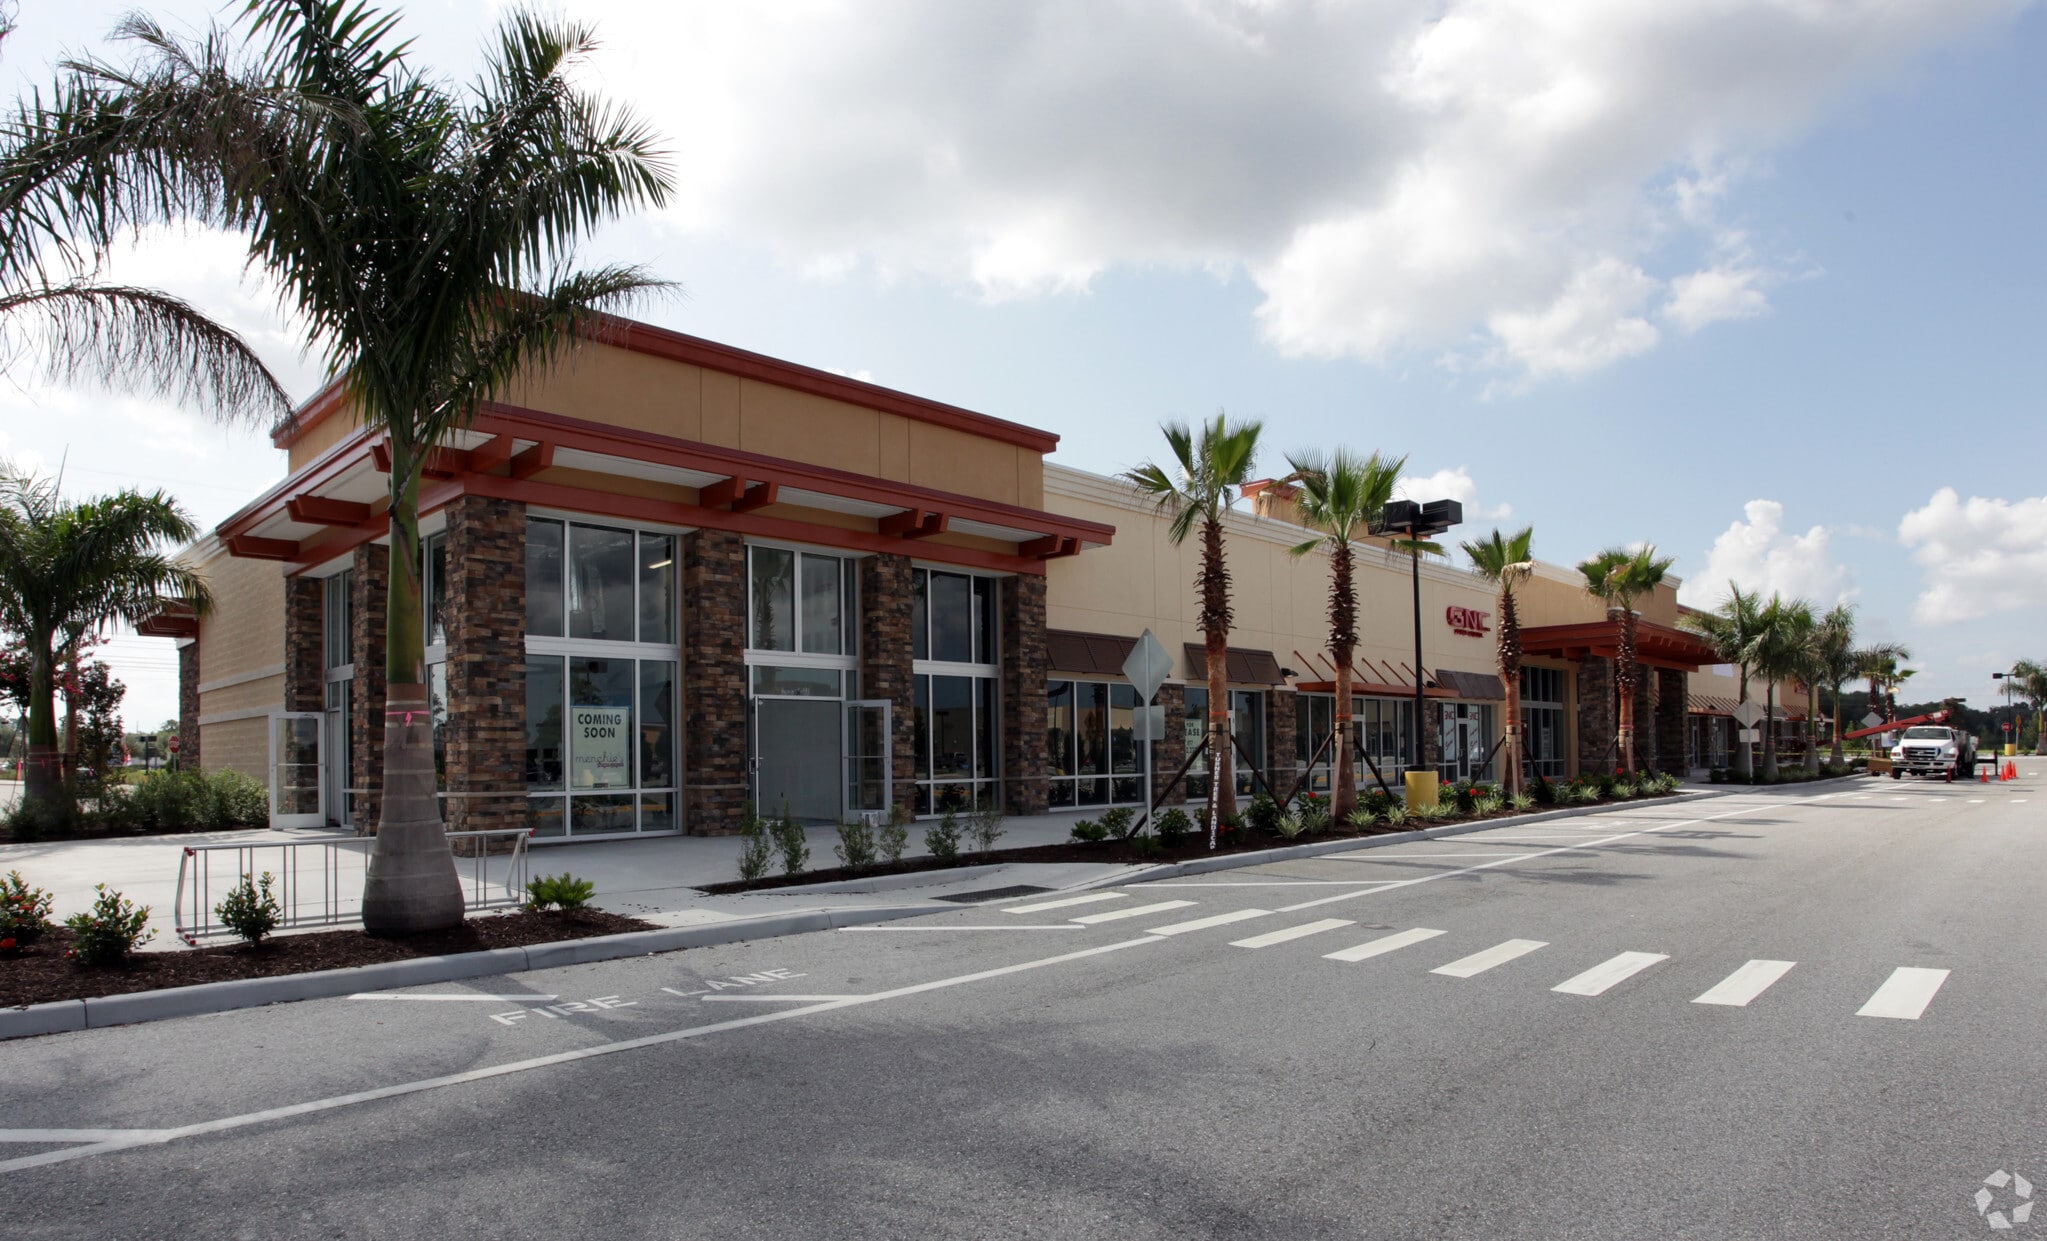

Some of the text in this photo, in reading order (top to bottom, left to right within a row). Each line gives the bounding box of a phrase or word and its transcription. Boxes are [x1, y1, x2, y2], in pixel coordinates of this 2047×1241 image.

[1446, 606, 1491, 631] GNC
[577, 713, 622, 725] COMING
[584, 727, 616, 738] SOON
[1184, 728, 1200, 736] EASE
[488, 968, 808, 1026] FIRE LANE
